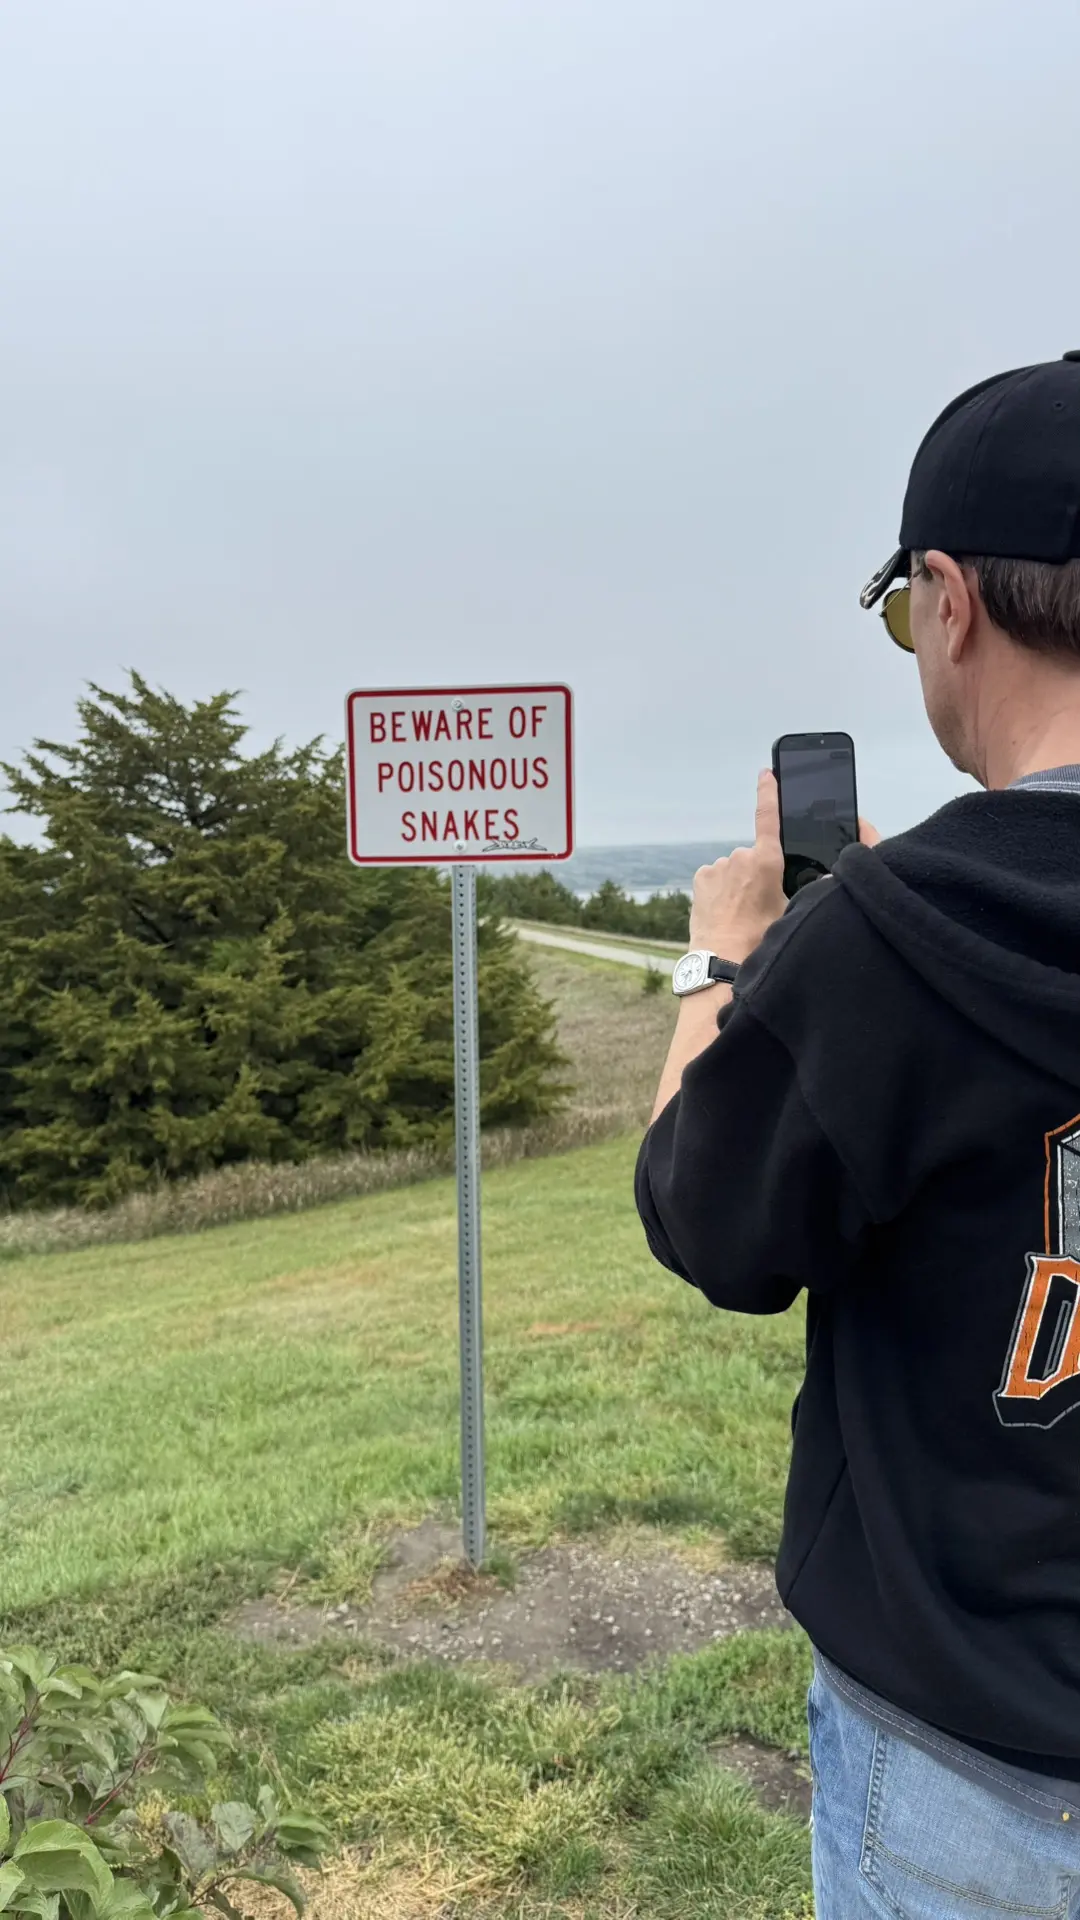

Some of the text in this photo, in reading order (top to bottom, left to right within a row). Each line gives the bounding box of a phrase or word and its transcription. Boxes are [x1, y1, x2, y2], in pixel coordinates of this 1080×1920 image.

[369, 705, 548, 744] BEWARE OF
[377, 757, 549, 793] POISONOUS
[401, 808, 520, 842] SNAKES
